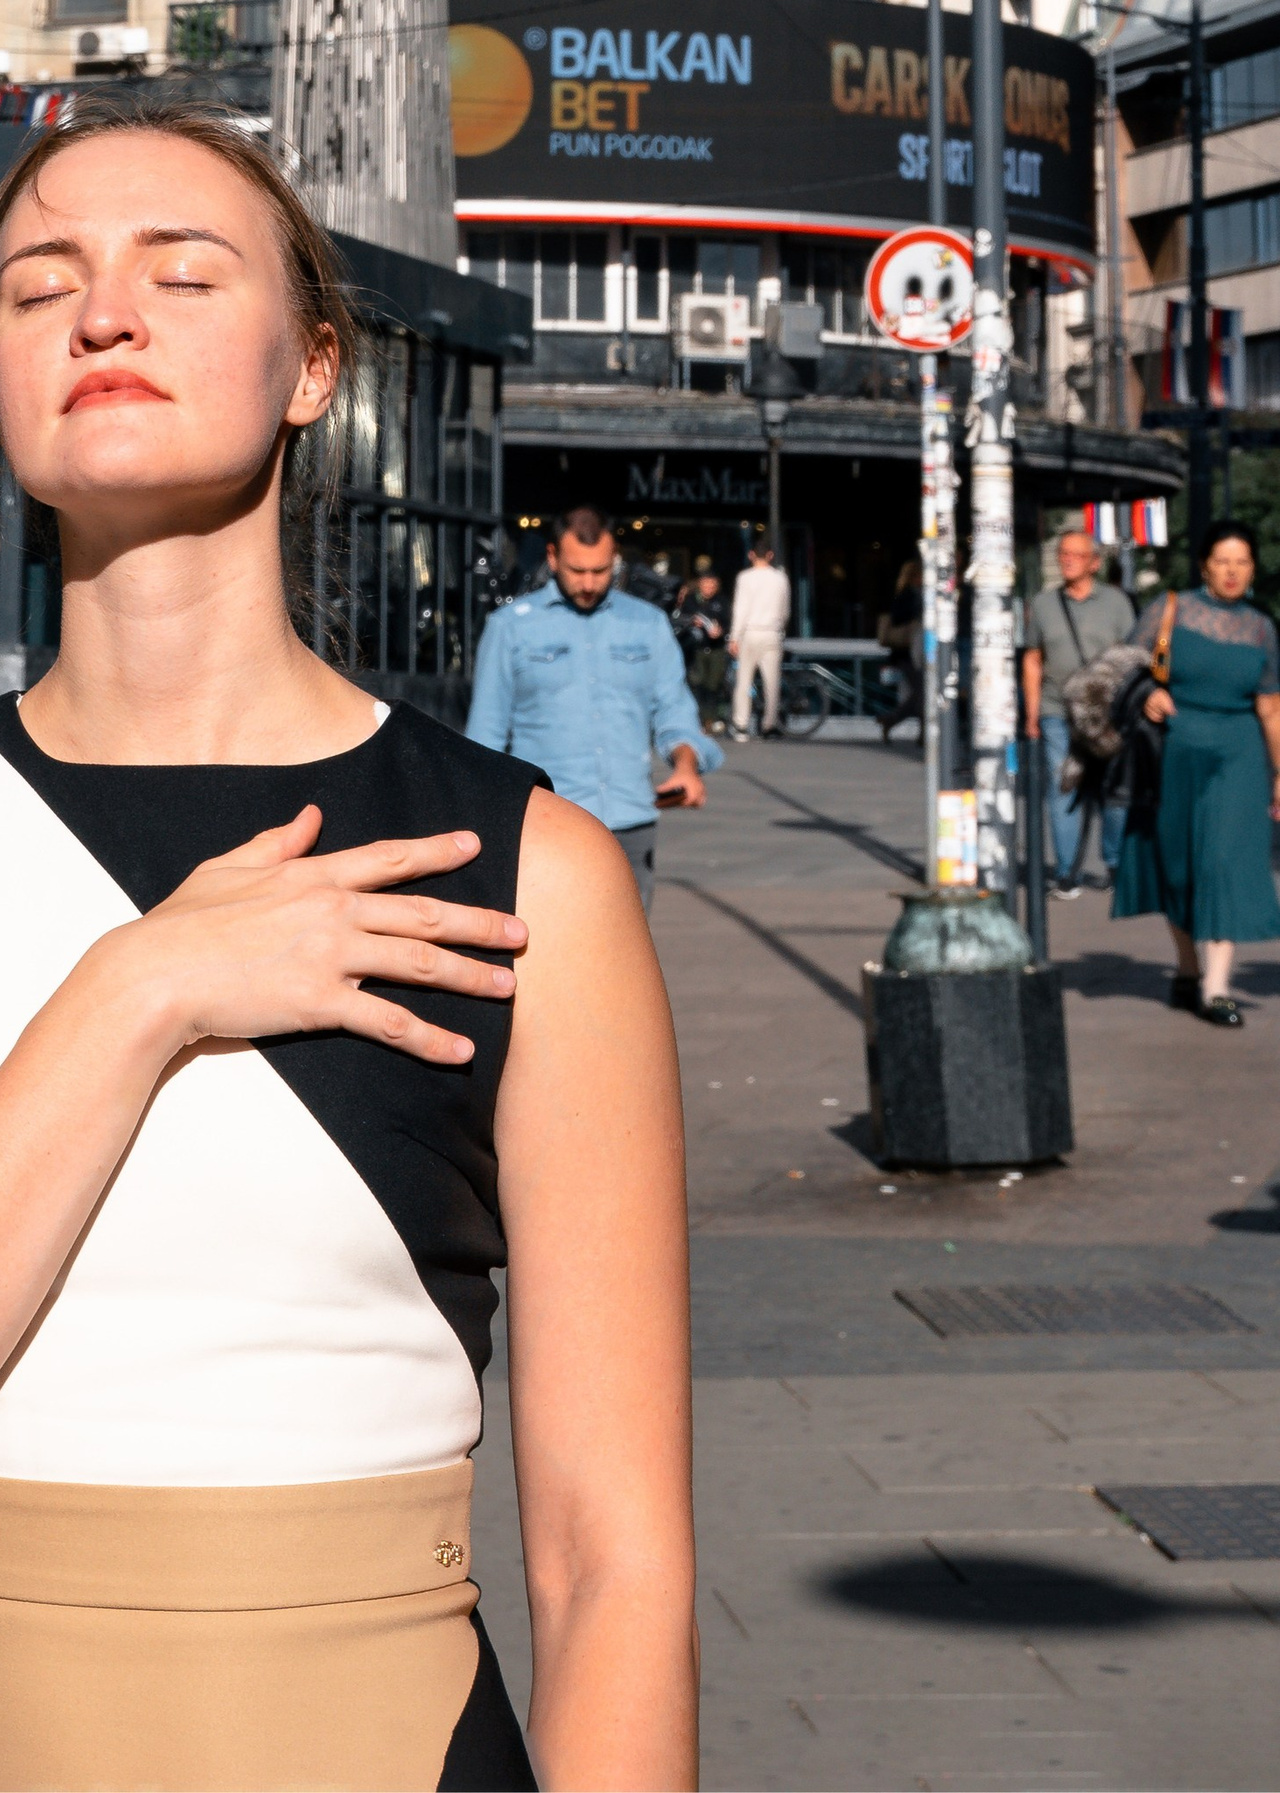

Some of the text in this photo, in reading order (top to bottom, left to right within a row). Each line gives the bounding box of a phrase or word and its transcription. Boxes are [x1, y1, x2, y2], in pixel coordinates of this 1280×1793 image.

[550, 27, 752, 85] BALKAN
[550, 80, 651, 132] BET
[549, 132, 713, 162] PUN POGODAK
[898, 132, 974, 186] SPRT
